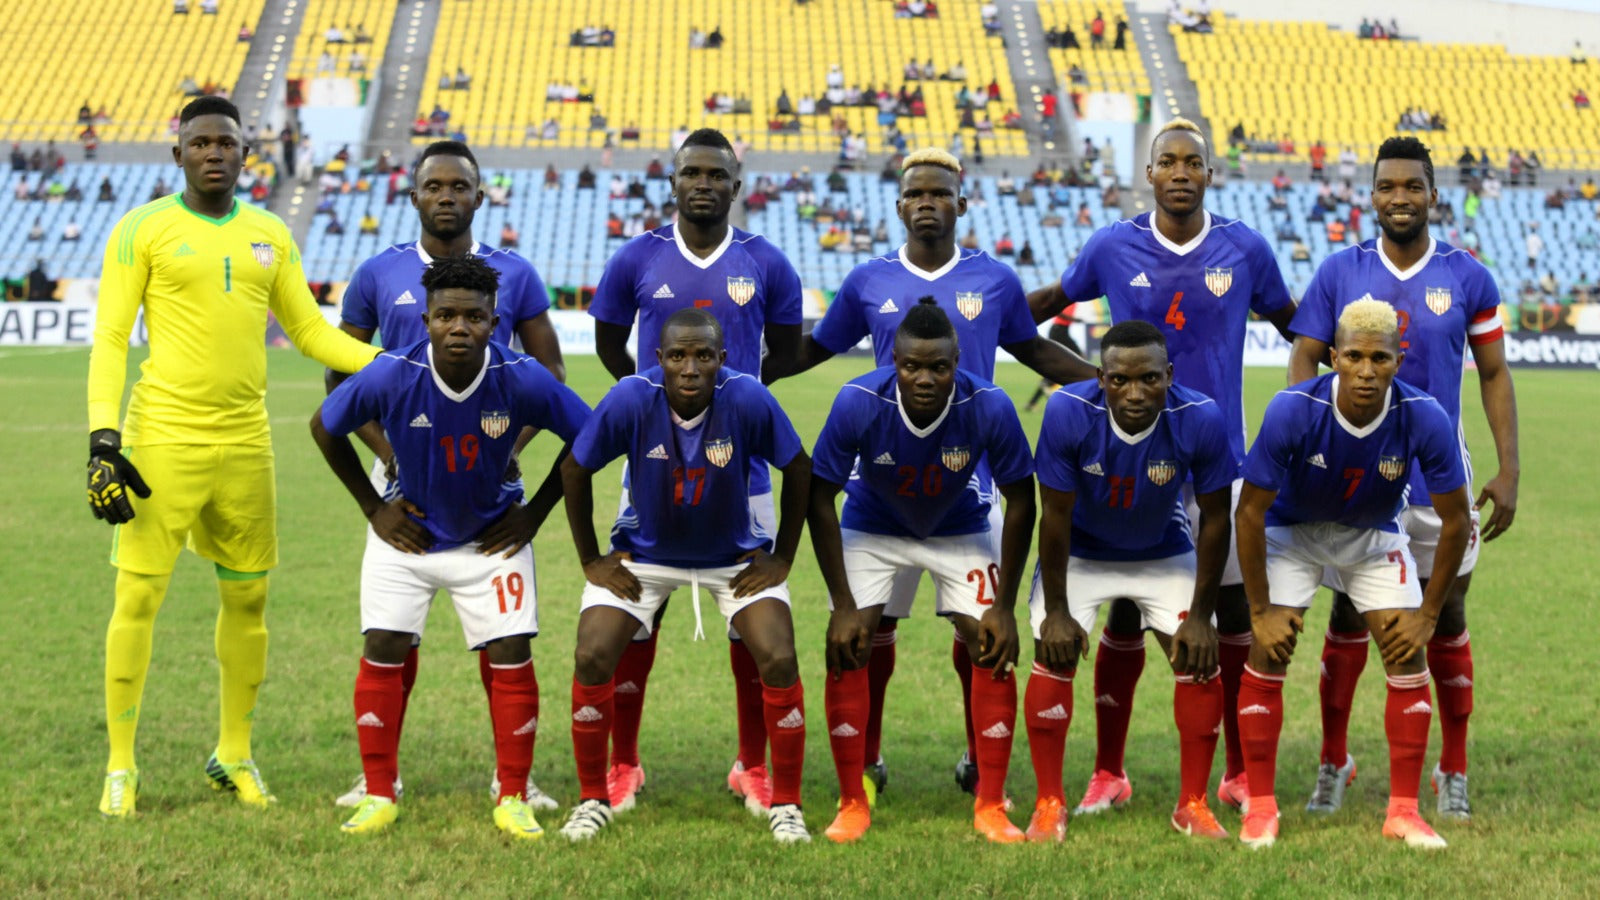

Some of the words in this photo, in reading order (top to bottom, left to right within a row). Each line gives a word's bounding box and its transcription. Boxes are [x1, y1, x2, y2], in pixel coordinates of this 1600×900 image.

[224, 256, 231, 292] 1
[0, 308, 90, 342] APE
[1165, 291, 1186, 331] 4
[1504, 333, 1600, 370] betwa
[440, 433, 479, 473] 19
[672, 466, 706, 506] 17
[896, 464, 943, 497] 20
[1107, 475, 1136, 509] 11
[1343, 467, 1365, 501] 7
[1386, 549, 1407, 585] 7
[491, 571, 525, 615] 19
